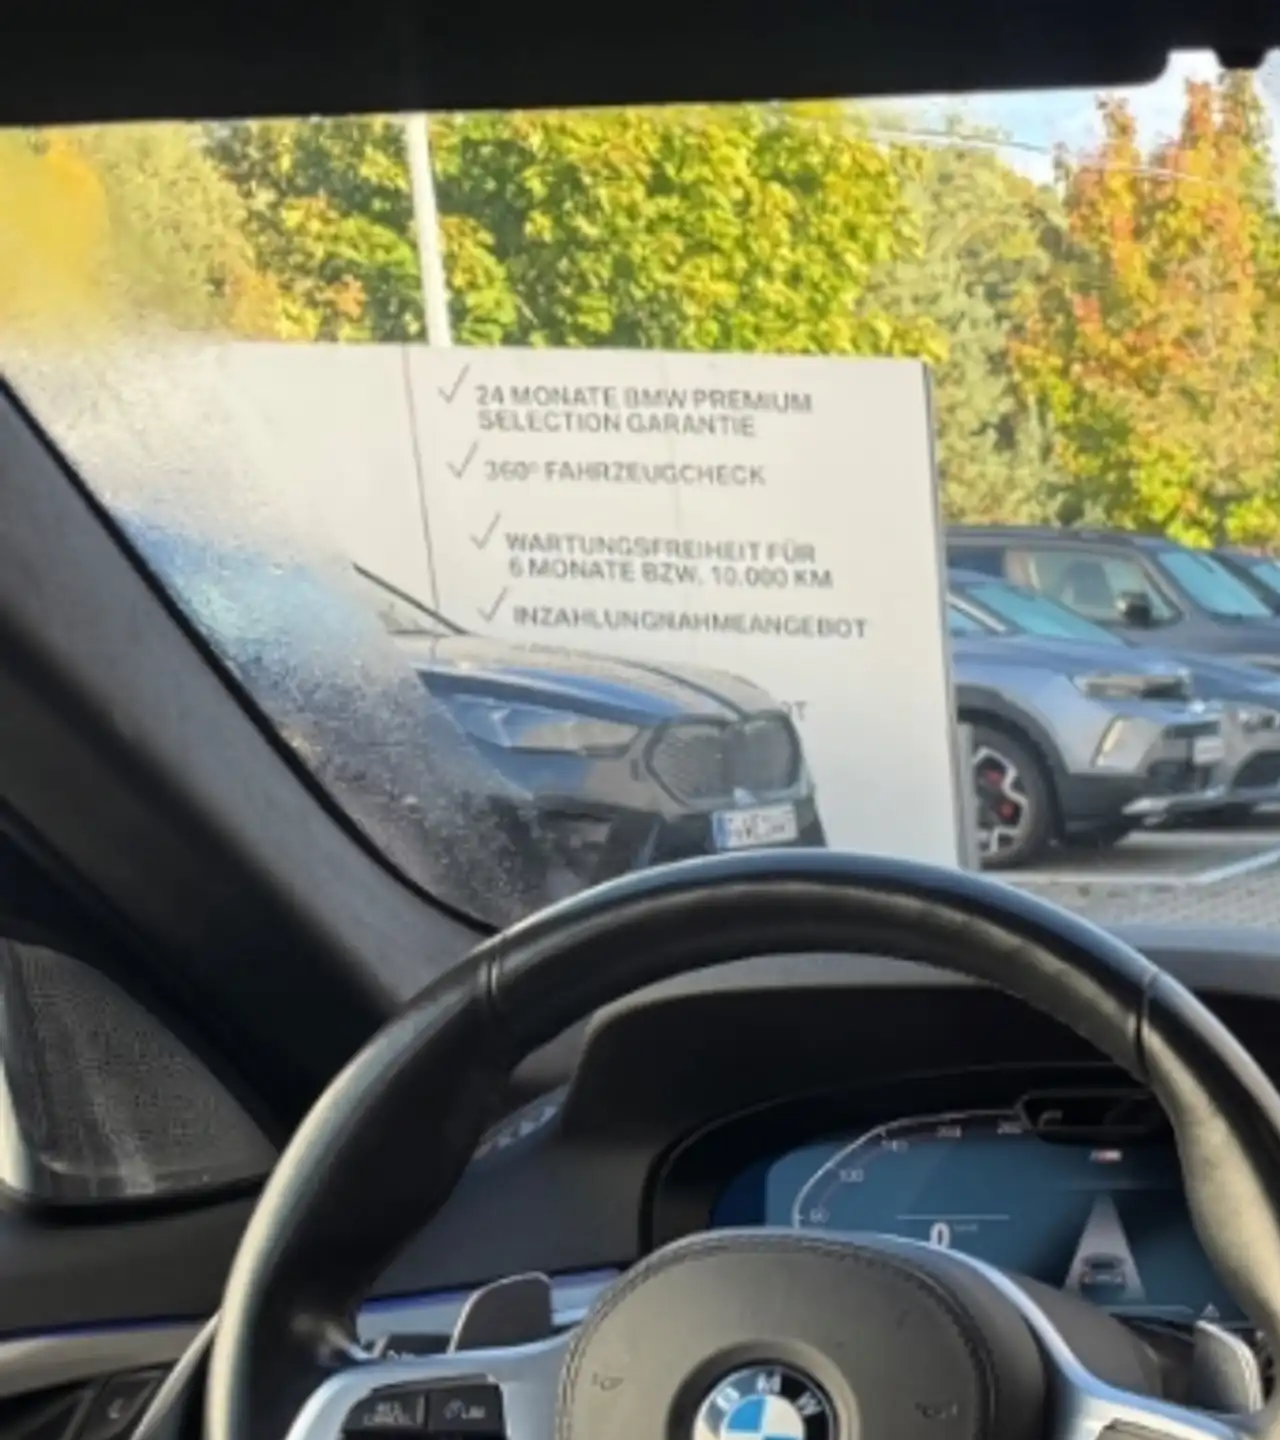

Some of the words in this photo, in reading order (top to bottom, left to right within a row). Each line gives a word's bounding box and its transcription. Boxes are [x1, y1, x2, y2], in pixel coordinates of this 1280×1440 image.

[475, 385, 505, 407] 24
[509, 385, 617, 409] MONATE
[623, 387, 688, 410] BMW
[691, 388, 814, 414] PREMIUM
[477, 409, 622, 434] SELECTION
[626, 412, 757, 437] GARANTIE
[544, 460, 767, 487] FAHRZEUGCHECK
[504, 532, 762, 563] WARTUNGSFREIHEIT
[767, 538, 817, 564] FÜR
[528, 558, 637, 582] MONATE
[640, 561, 704, 586] BZW.
[711, 564, 788, 588] 10.000
[793, 568, 834, 588] KM
[513, 604, 869, 640] INZAHLUNGNAHMEANGEBOT
